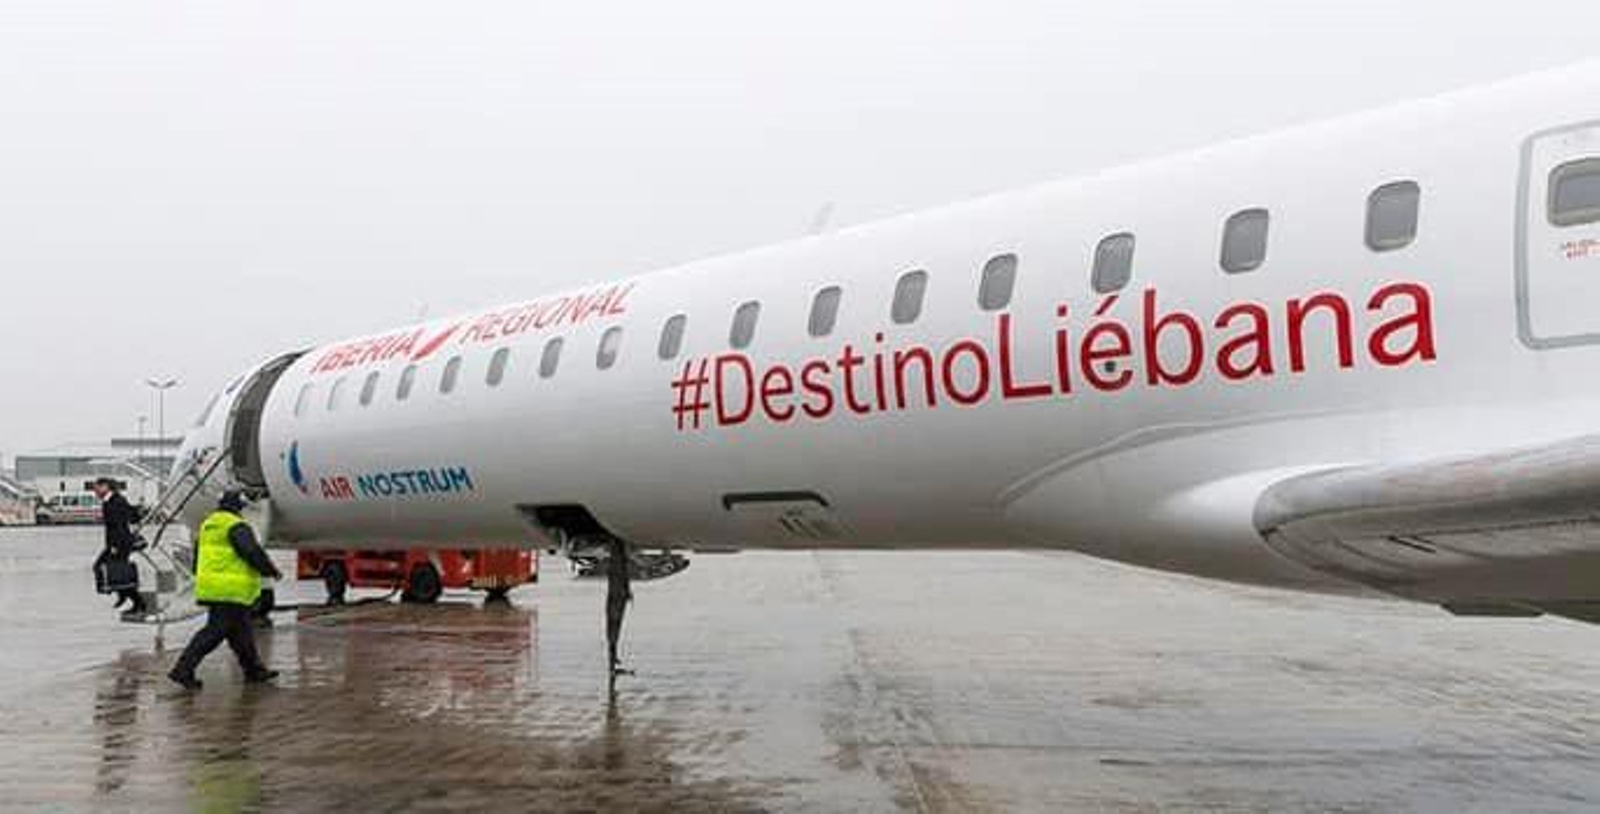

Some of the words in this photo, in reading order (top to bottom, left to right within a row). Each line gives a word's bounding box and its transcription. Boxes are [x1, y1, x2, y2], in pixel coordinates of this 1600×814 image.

[310, 329, 424, 374] IBERIA
[459, 284, 635, 344] REGIONAL
[671, 282, 1437, 430] #DestinoLiébana
[320, 476, 355, 499] AIR
[358, 467, 474, 497] NOSTRUM
